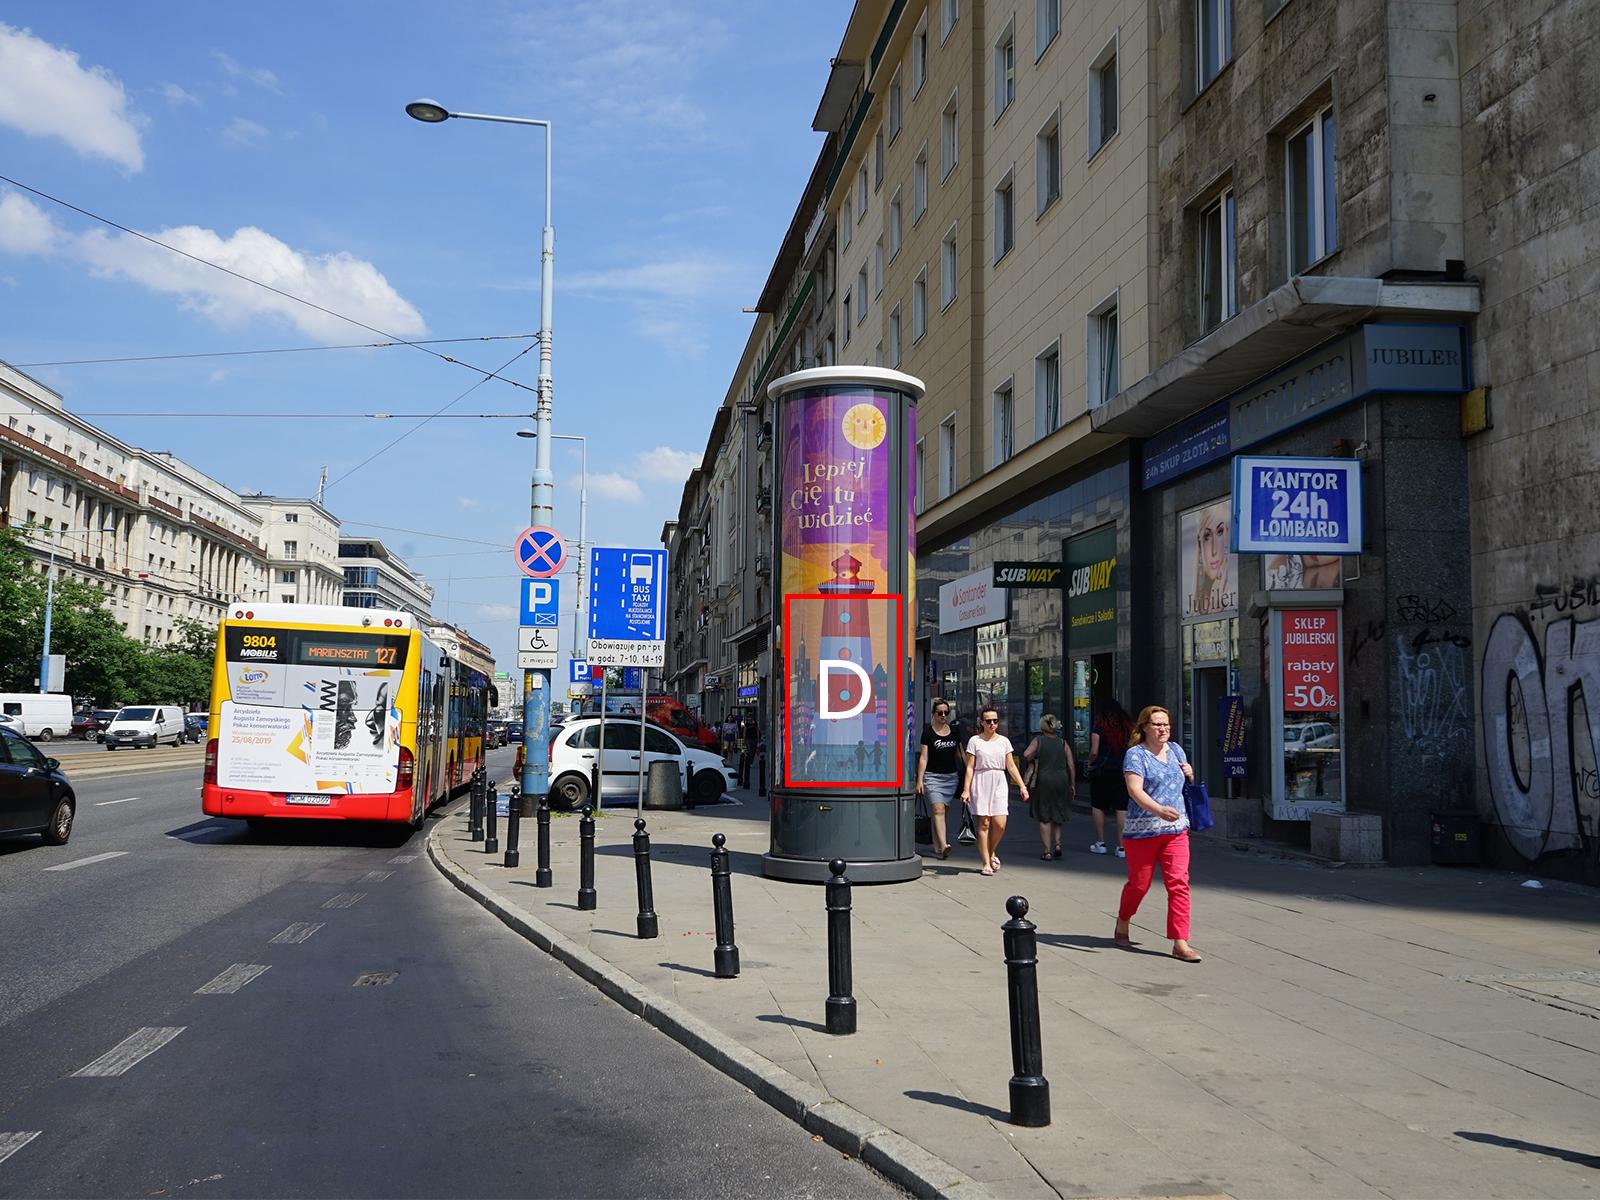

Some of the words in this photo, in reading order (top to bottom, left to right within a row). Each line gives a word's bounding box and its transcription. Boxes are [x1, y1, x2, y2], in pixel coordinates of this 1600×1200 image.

[1369, 349, 1458, 365] JUBILER
[803, 457, 865, 483] Lepiej
[1160, 454, 1180, 473] SKUP
[1260, 471, 1338, 489] KANTOR
[791, 485, 822, 510] Cię
[834, 485, 855, 504] tu
[1271, 490, 1328, 519] 24h
[798, 505, 873, 529] widzieć
[1260, 519, 1339, 538] LOMBARD
[996, 568, 1061, 582] SUBWAY
[1068, 557, 1117, 598] SUBWAY
[633, 585, 650, 593] BUS
[632, 594, 650, 602] TAXI
[1186, 589, 1237, 614] Jubiler
[1294, 617, 1326, 629] SKLEP
[243, 635, 276, 648] 9804
[591, 640, 635, 652] Obowiązuje
[1285, 633, 1335, 645] JUBILERSKI
[240, 648, 278, 658] MOBILIS
[308, 647, 369, 660] MARIENSZTAT
[375, 647, 397, 664] 127
[597, 654, 617, 664] godz.
[642, 655, 663, 664] 14-19
[1287, 660, 1335, 673] rabaty
[244, 672, 263, 681] LOTTO
[1303, 672, 1320, 682] do
[1287, 685, 1337, 707] -50%
[231, 736, 272, 744] 25/08/2019
